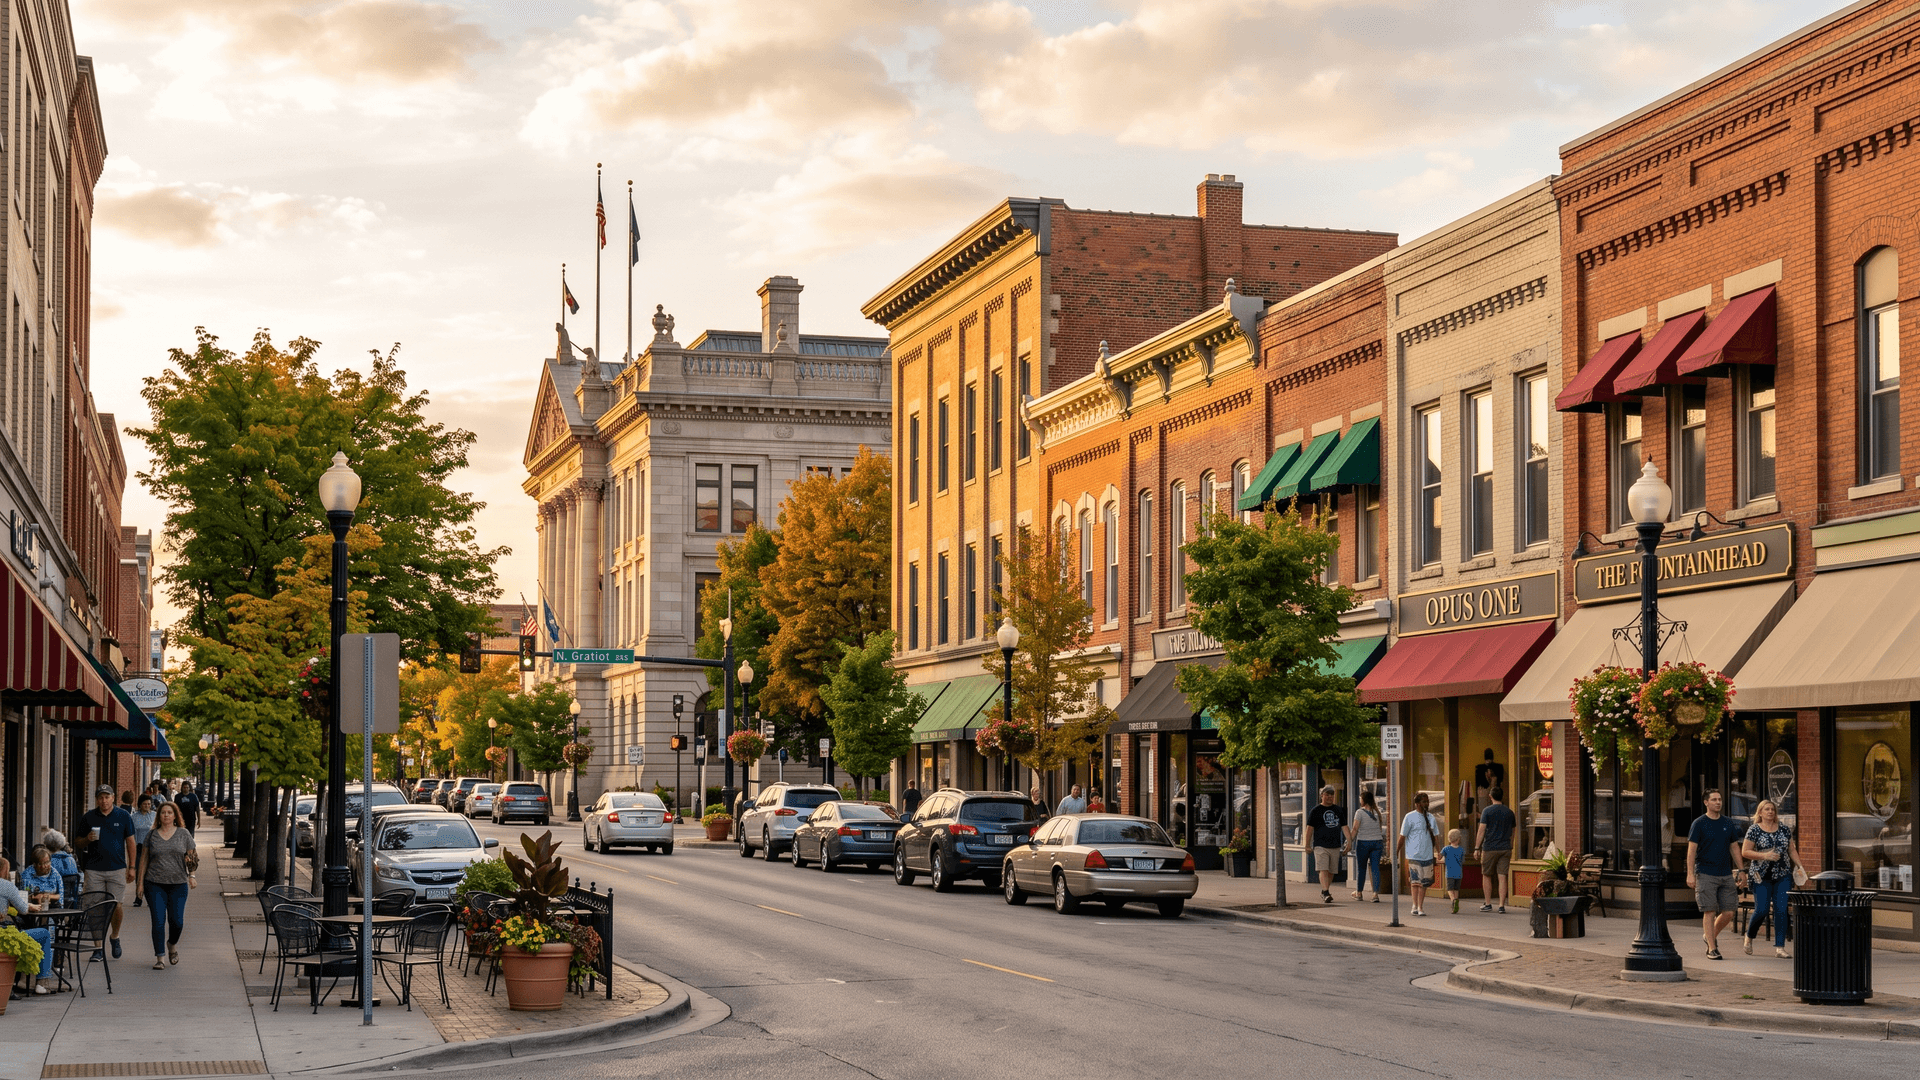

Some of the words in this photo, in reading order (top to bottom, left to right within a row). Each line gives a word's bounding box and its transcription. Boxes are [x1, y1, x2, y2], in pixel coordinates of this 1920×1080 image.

[1595, 563, 1627, 590] THE
[1425, 592, 1475, 626] OPUS
[1479, 585, 1521, 618] ONE
[556, 651, 567, 661] N.
[571, 651, 610, 661] Gratiot
